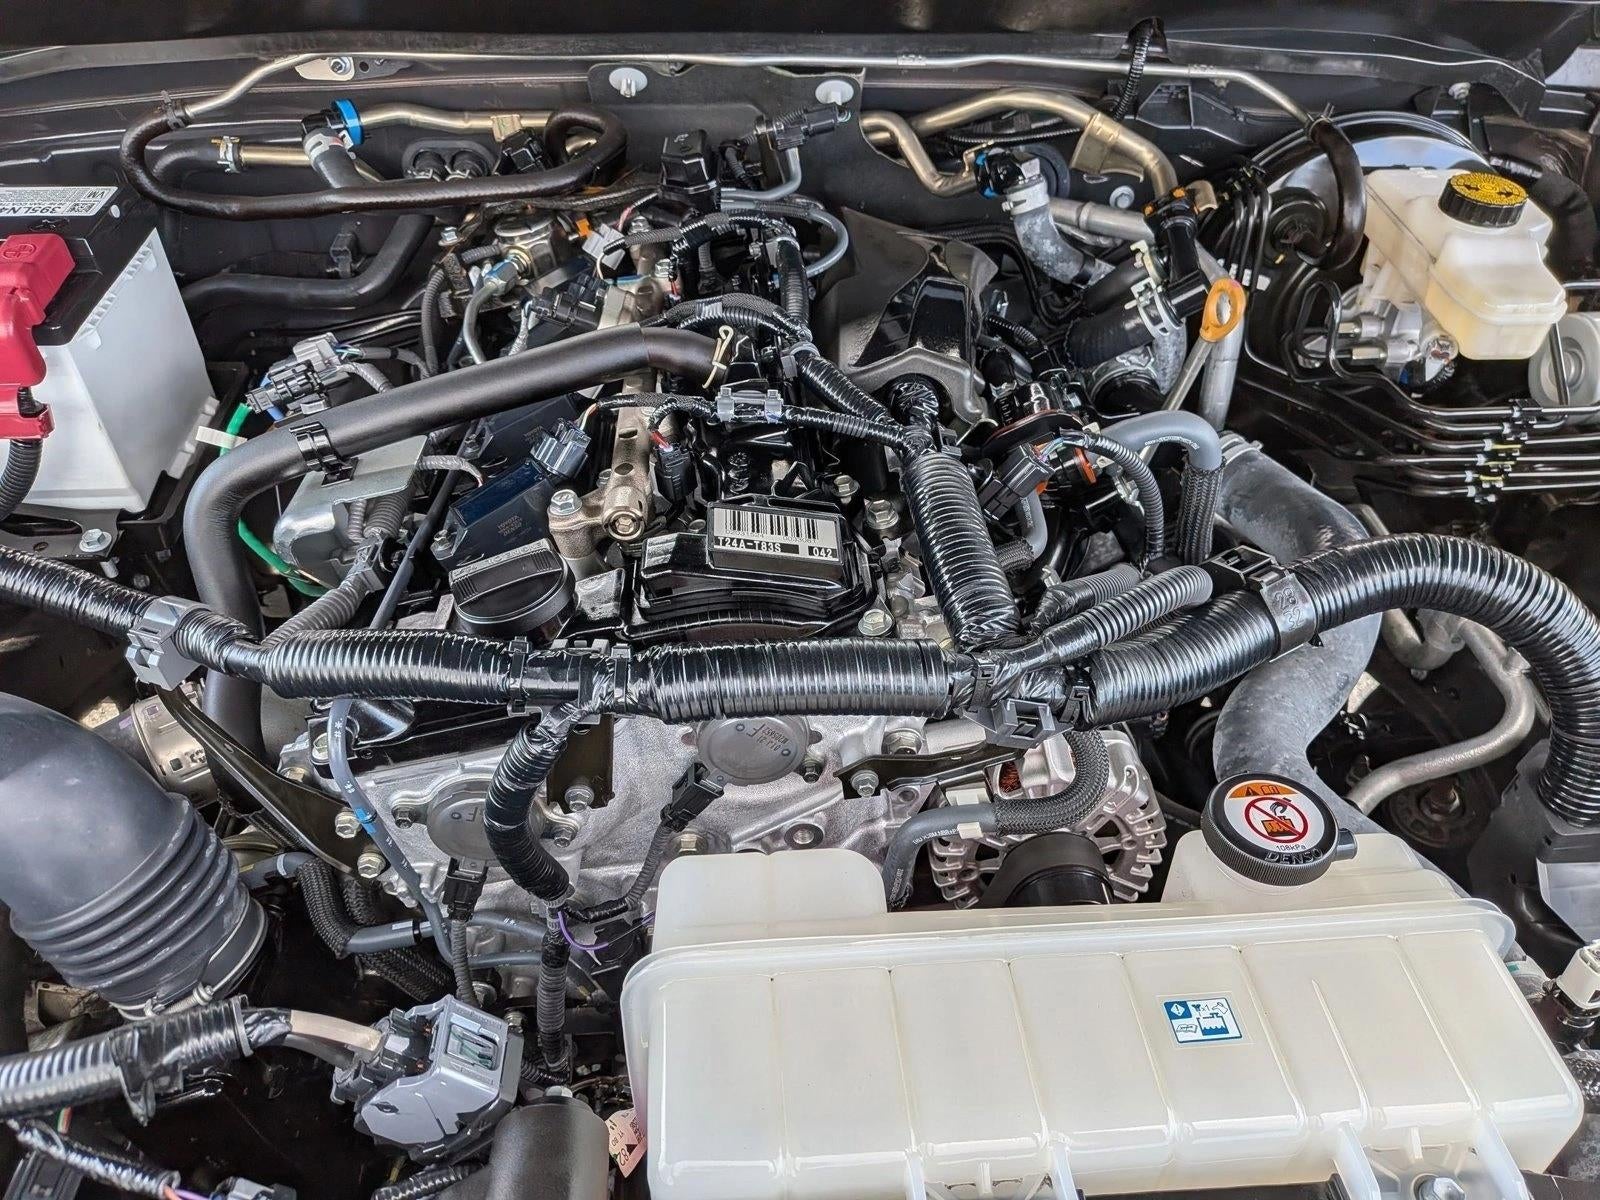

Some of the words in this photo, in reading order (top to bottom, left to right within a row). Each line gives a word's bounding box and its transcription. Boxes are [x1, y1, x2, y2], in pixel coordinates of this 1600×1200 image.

[718, 537, 781, 553] T24A-T83S
[813, 547, 833, 558] 042
[1273, 587, 1297, 611] 28
[1283, 606, 1306, 631] 32
[1265, 847, 1324, 865] DENSO
[1276, 843, 1307, 853] 108kPa
[619, 1148, 630, 1167] 82
